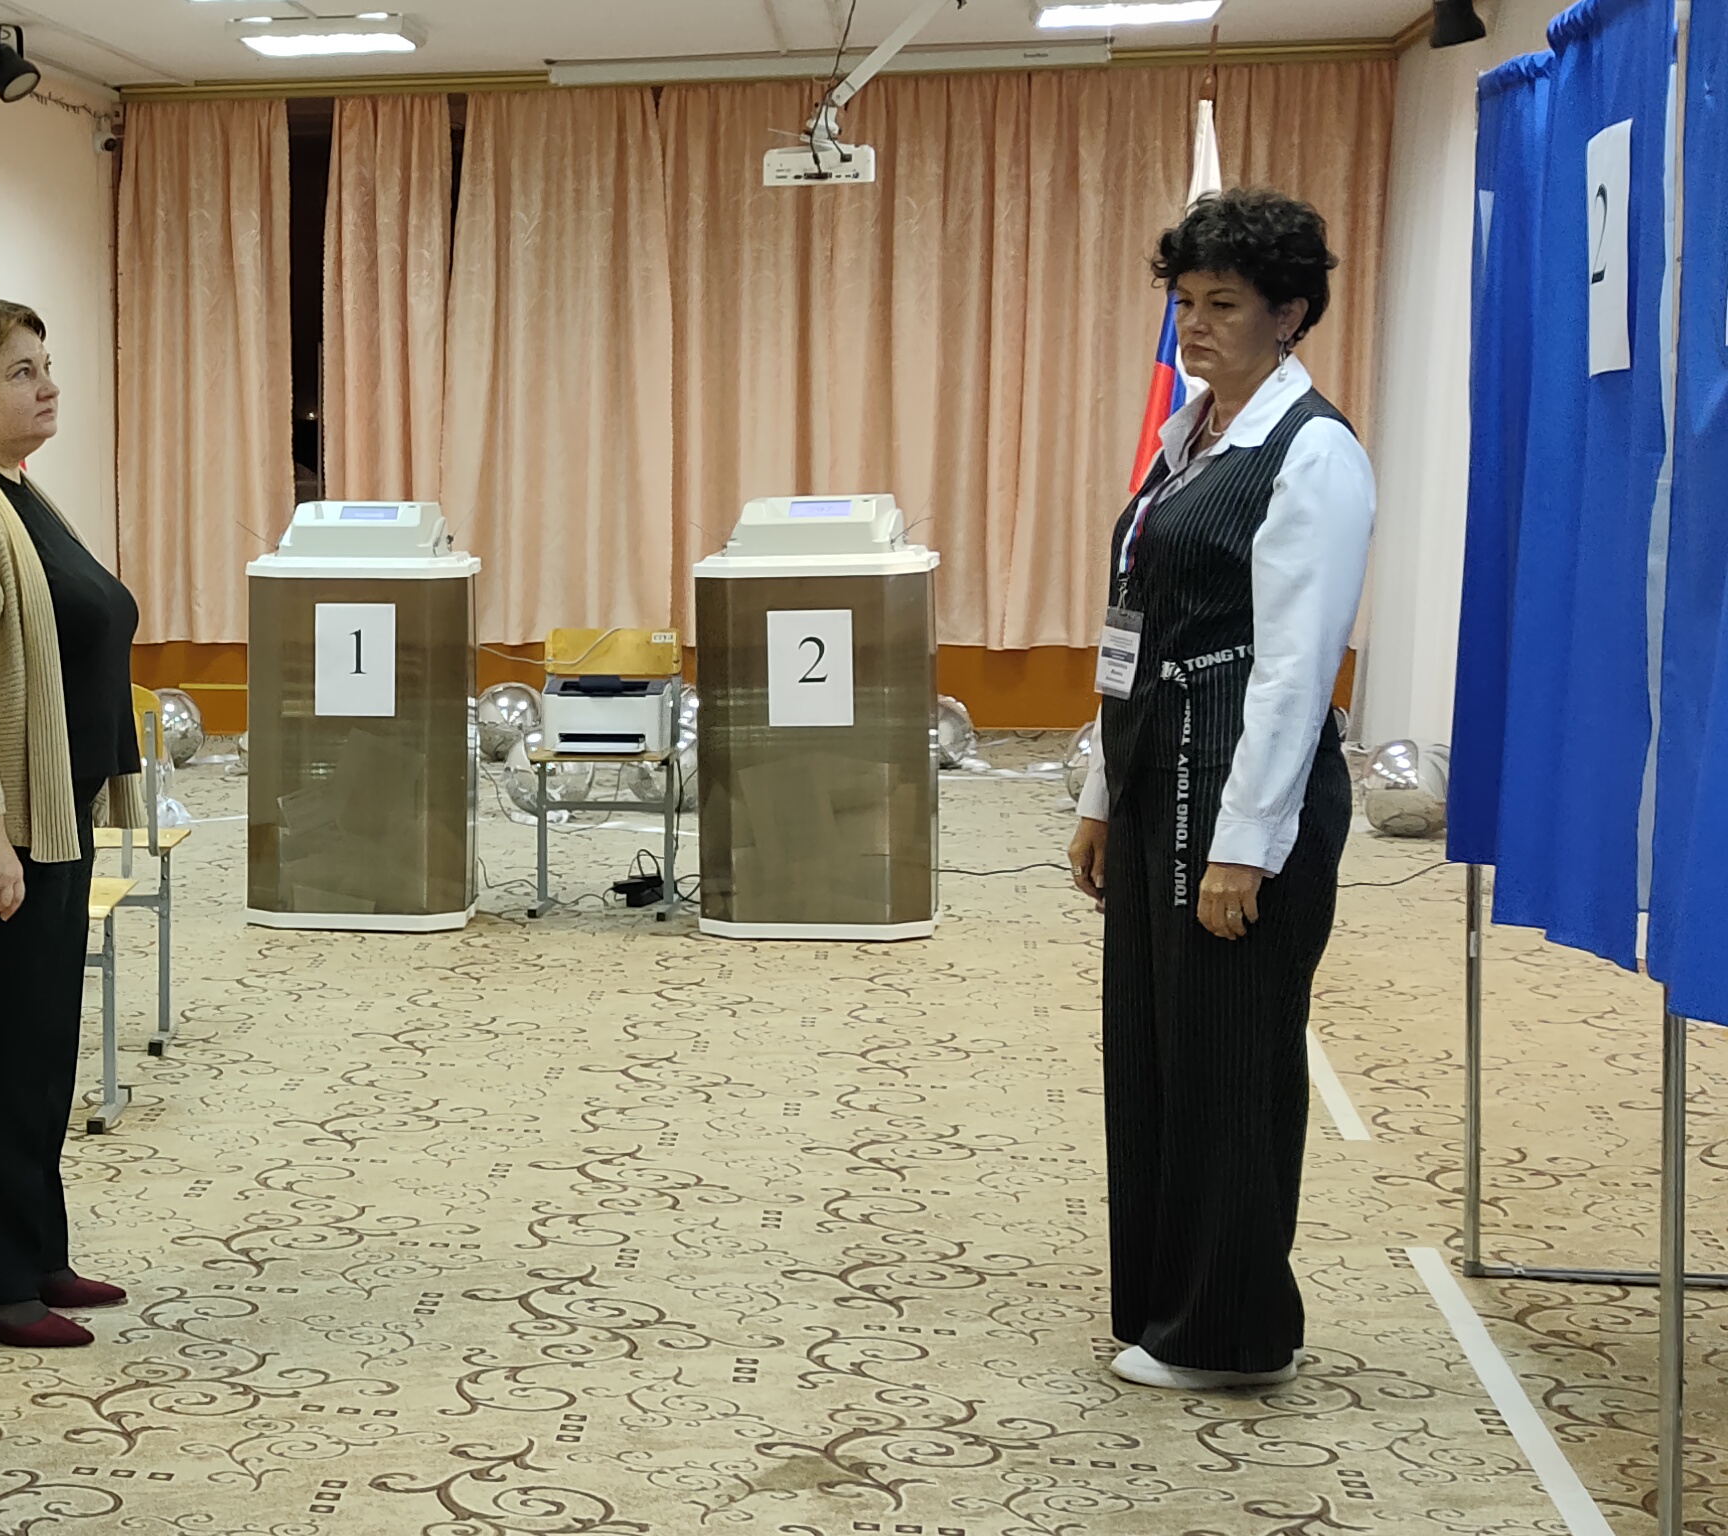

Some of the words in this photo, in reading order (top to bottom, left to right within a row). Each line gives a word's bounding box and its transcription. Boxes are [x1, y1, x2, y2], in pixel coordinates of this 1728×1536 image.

[1590, 183, 1608, 285] 2
[349, 629, 367, 675] 1
[798, 636, 828, 683] 2
[1183, 649, 1234, 672] TONG
[1175, 803, 1189, 852] TONG
